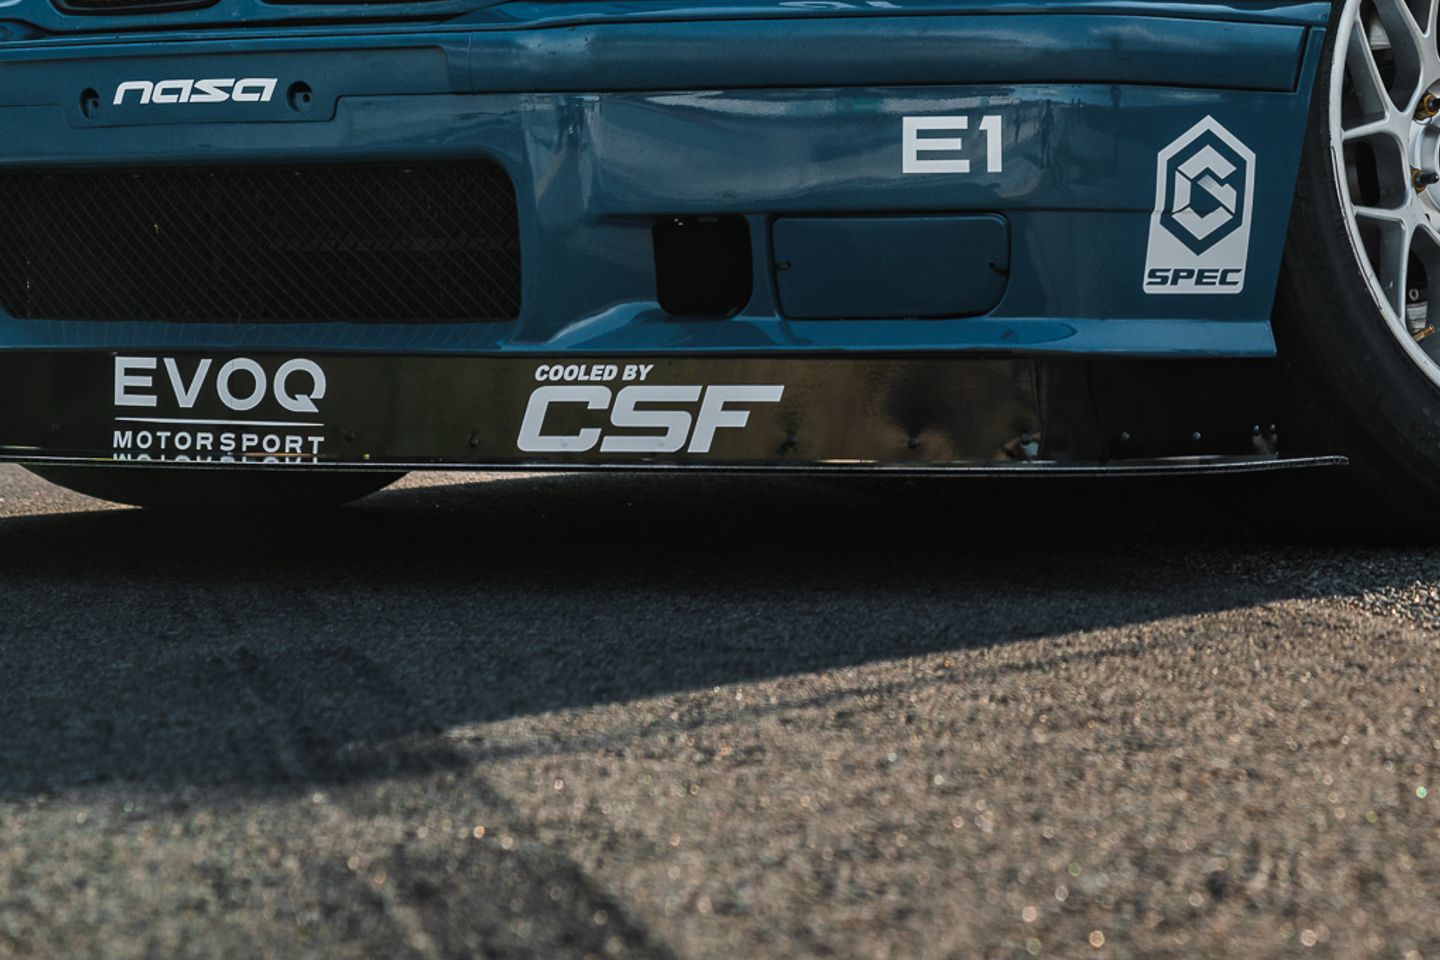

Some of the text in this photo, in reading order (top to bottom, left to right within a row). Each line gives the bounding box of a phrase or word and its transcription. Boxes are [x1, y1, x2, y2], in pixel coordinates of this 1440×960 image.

[113, 77, 279, 105] nasa
[903, 115, 1003, 174] E1
[1146, 268, 1243, 287] SPEC
[114, 356, 327, 413] EVOQ
[534, 364, 654, 381] COOLED BY
[516, 385, 785, 453] CSF
[112, 430, 325, 455] MOTORSPORT
